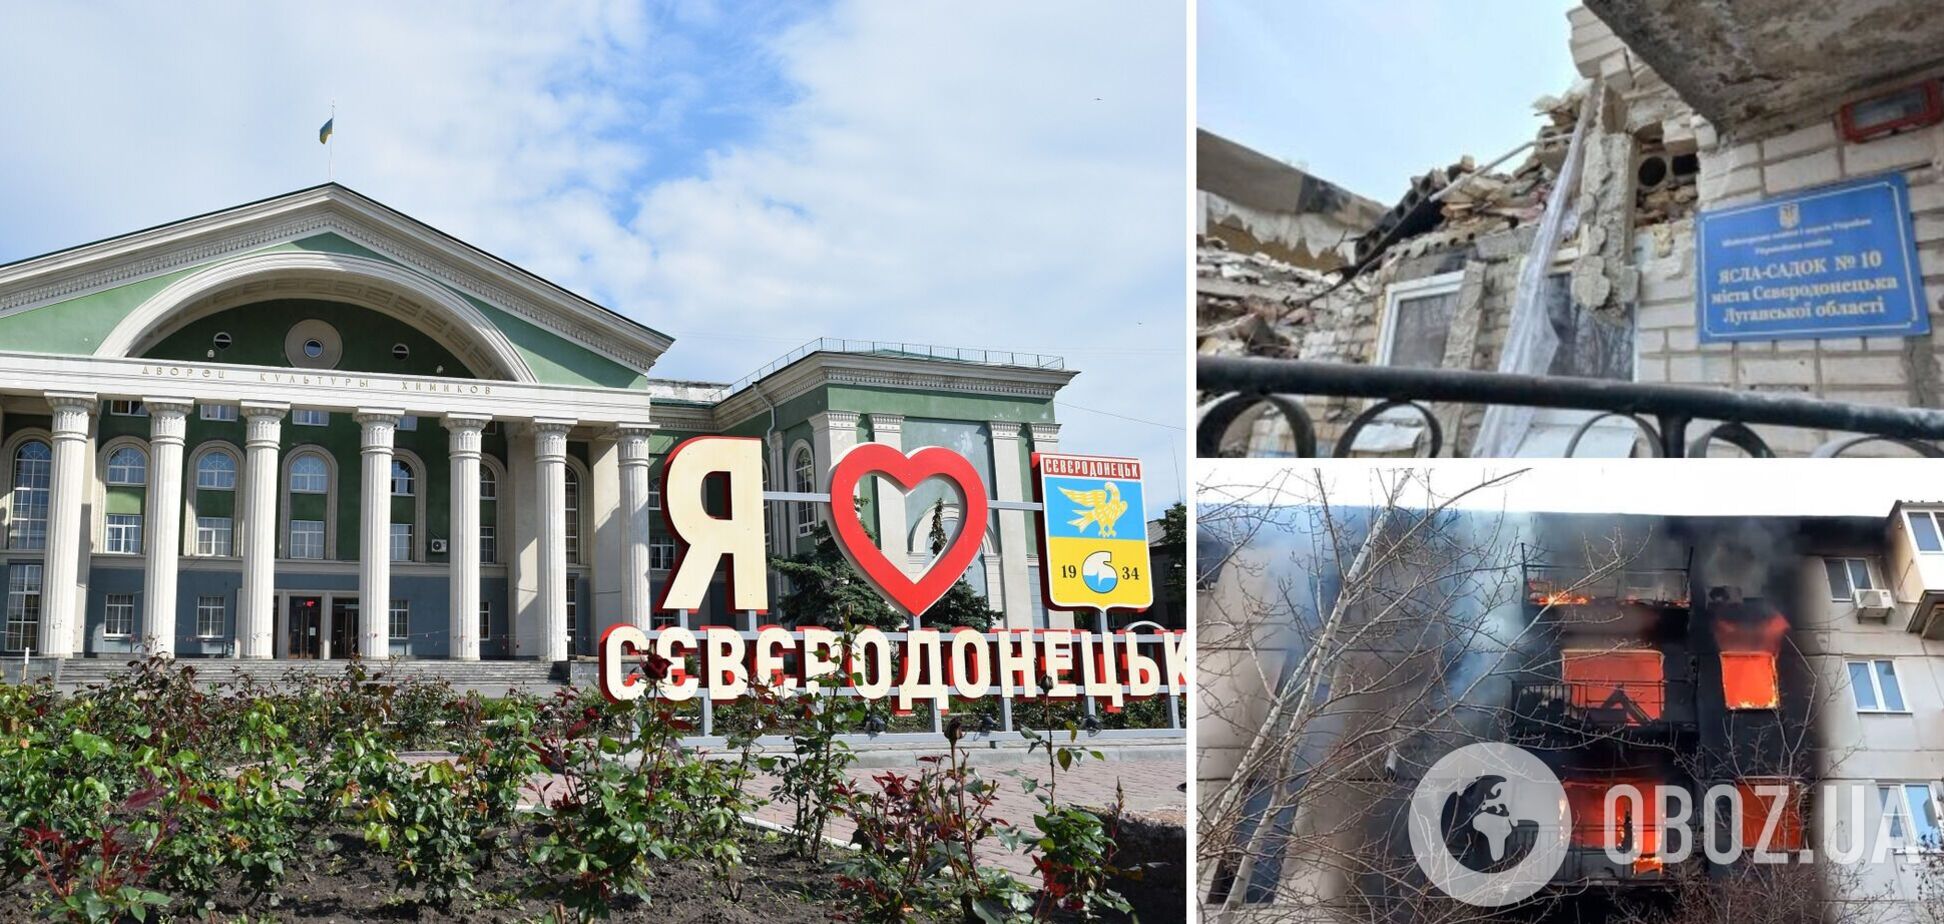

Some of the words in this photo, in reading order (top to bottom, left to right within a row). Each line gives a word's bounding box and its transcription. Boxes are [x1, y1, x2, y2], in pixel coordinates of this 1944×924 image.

[1718, 257, 1827, 285] ЯСЛА-САДОК
[1834, 255, 1856, 269] №
[1861, 250, 1882, 268] 10
[1711, 290, 1750, 305] міста
[1723, 302, 1812, 326] Луганської
[1815, 296, 1885, 318] області
[142, 366, 225, 380] ДВОРЕЦ
[260, 372, 369, 388] КУЛЬТУРЫ
[401, 380, 491, 395] ХИМИКОВ
[1044, 458, 1139, 479] СЄВЄРОДОНЕЦЬК
[658, 436, 768, 612] Я
[1062, 564, 1077, 579] 19
[1122, 566, 1140, 580] 34
